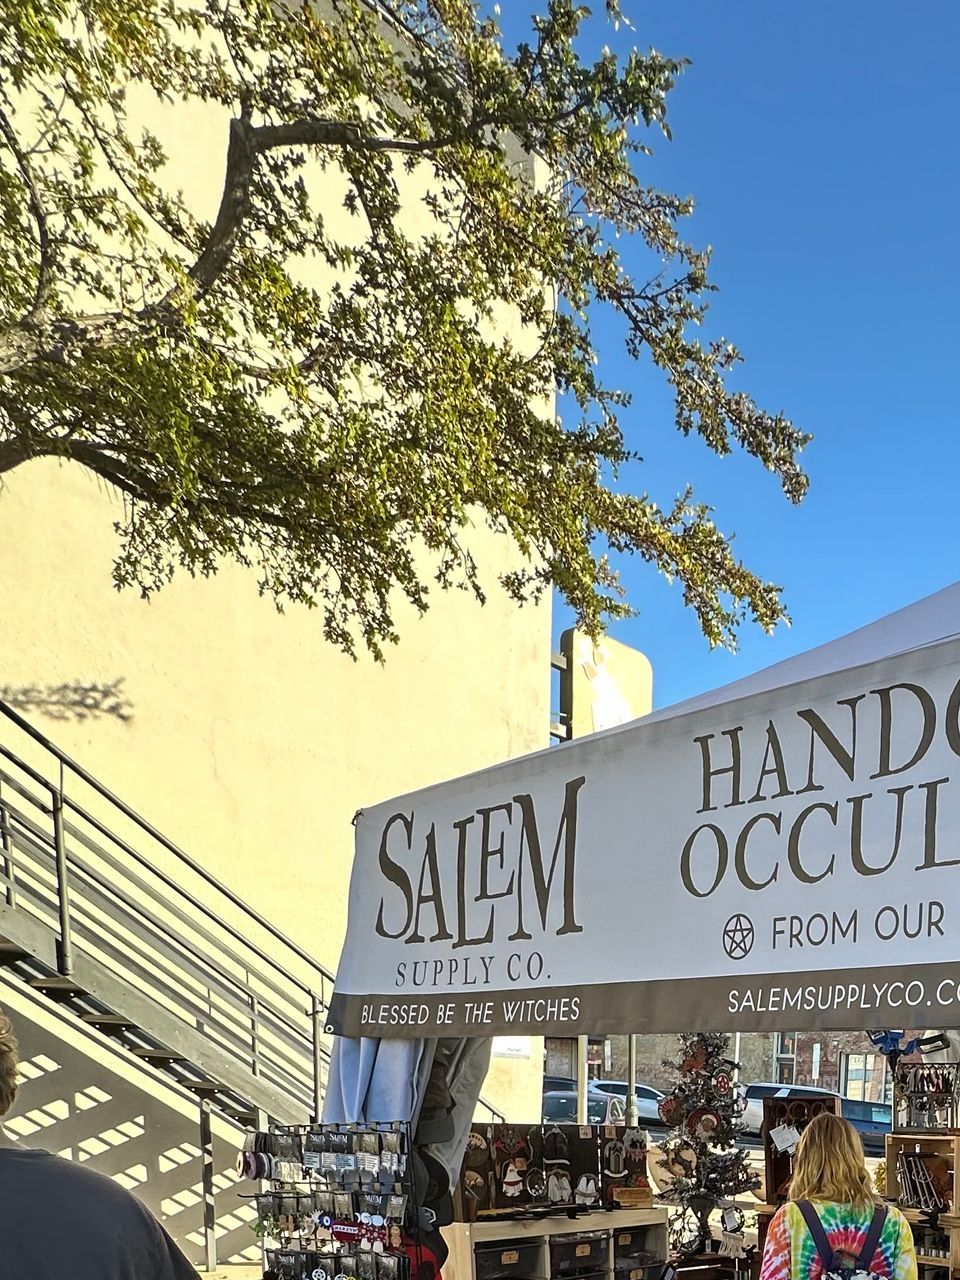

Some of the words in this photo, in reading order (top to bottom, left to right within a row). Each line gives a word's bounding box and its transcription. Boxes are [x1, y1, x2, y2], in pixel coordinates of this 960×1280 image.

[375, 776, 586, 950] SALEM
[772, 905, 858, 949] FROM
[874, 900, 945, 941] OUR
[395, 955, 496, 988] SUPPLY
[506, 950, 552, 982] CO.
[360, 1003, 430, 1026] BLESSED
[436, 1003, 456, 1025] BE
[464, 1002, 495, 1024] THE
[503, 996, 580, 1023] WITCHES
